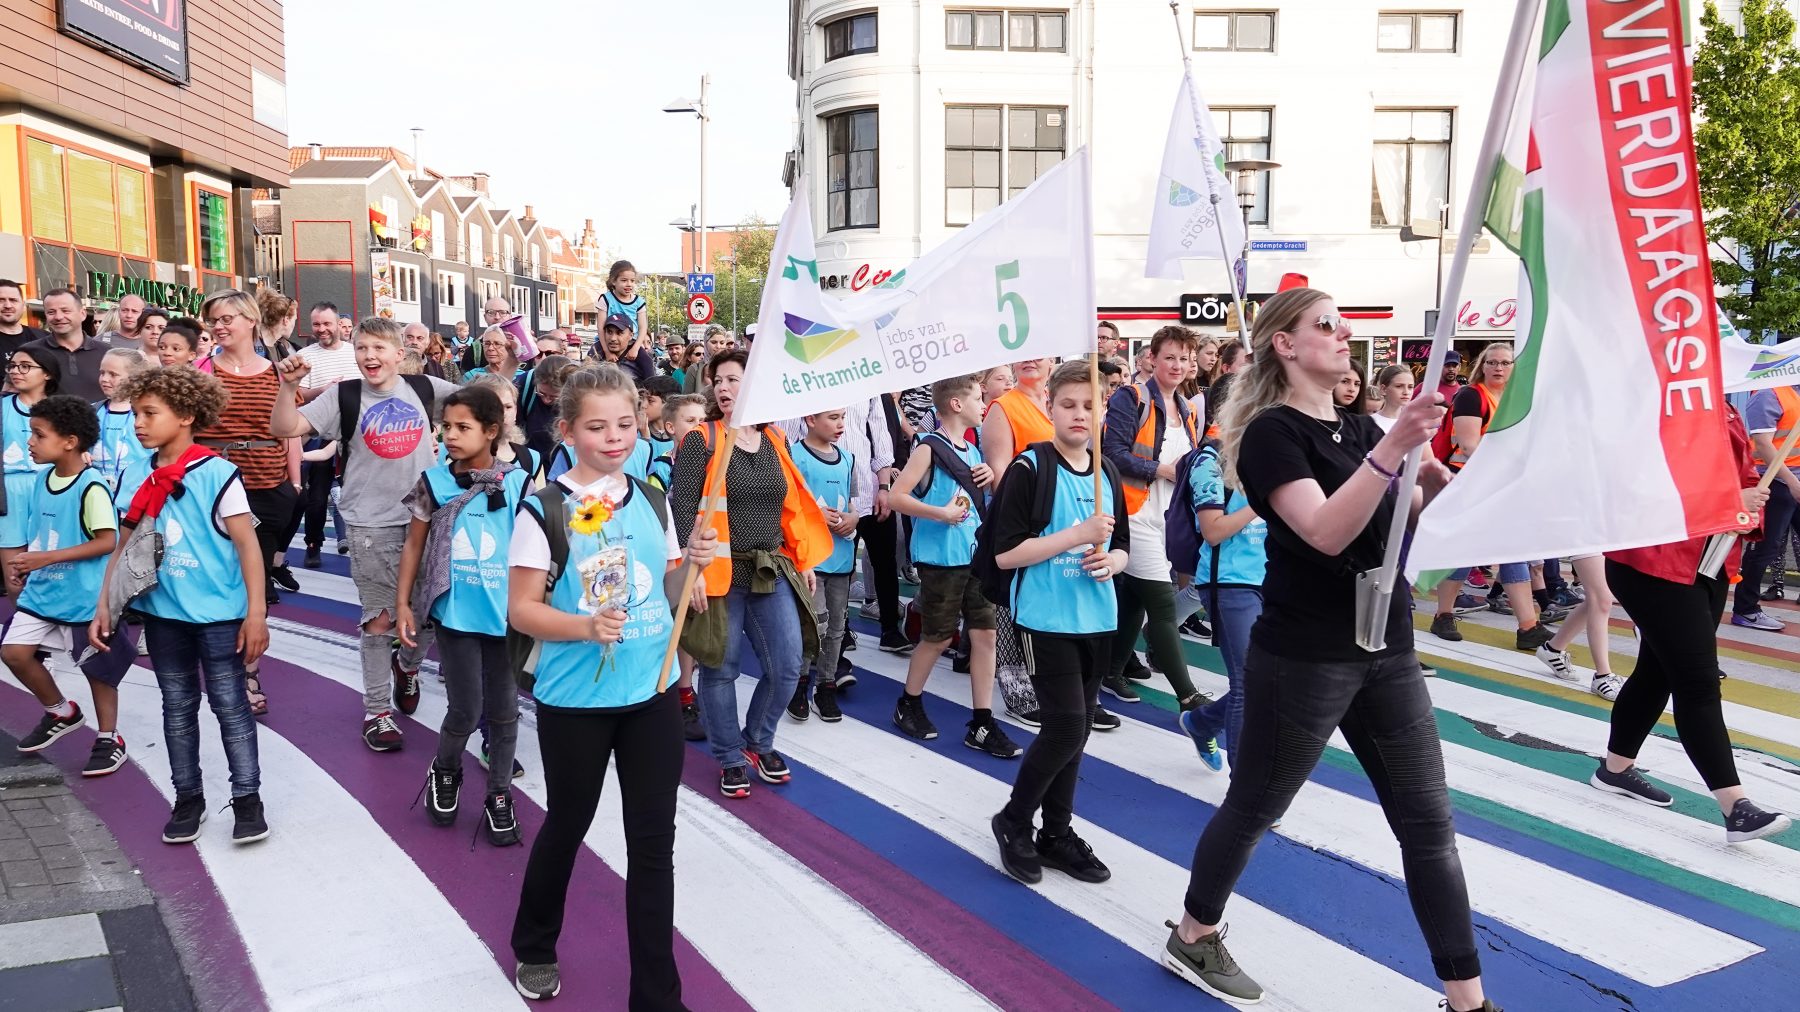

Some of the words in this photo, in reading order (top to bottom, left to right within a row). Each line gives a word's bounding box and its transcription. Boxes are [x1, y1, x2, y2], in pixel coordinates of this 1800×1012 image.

[79, 0, 104, 13] RATIS
[134, 20, 153, 37] FOOD
[157, 33, 180, 51] DRINKS
[1602, 0, 1713, 417] VIERDAAGSE
[217, 200, 227, 270] CASINO
[1252, 242, 1283, 250] Gedempte
[88, 271, 192, 310] FLAMINGO
[994, 259, 1030, 350] 5
[1457, 300, 1481, 327] le
[886, 328, 915, 346] icbs
[917, 320, 947, 337] van
[892, 333, 970, 374] agora
[782, 373, 802, 395] de
[801, 357, 883, 392] Piramide
[362, 413, 425, 438] Mount
[371, 433, 418, 446] GRANITE
[1053, 556, 1064, 565] de
[1063, 568, 1081, 578] 075
